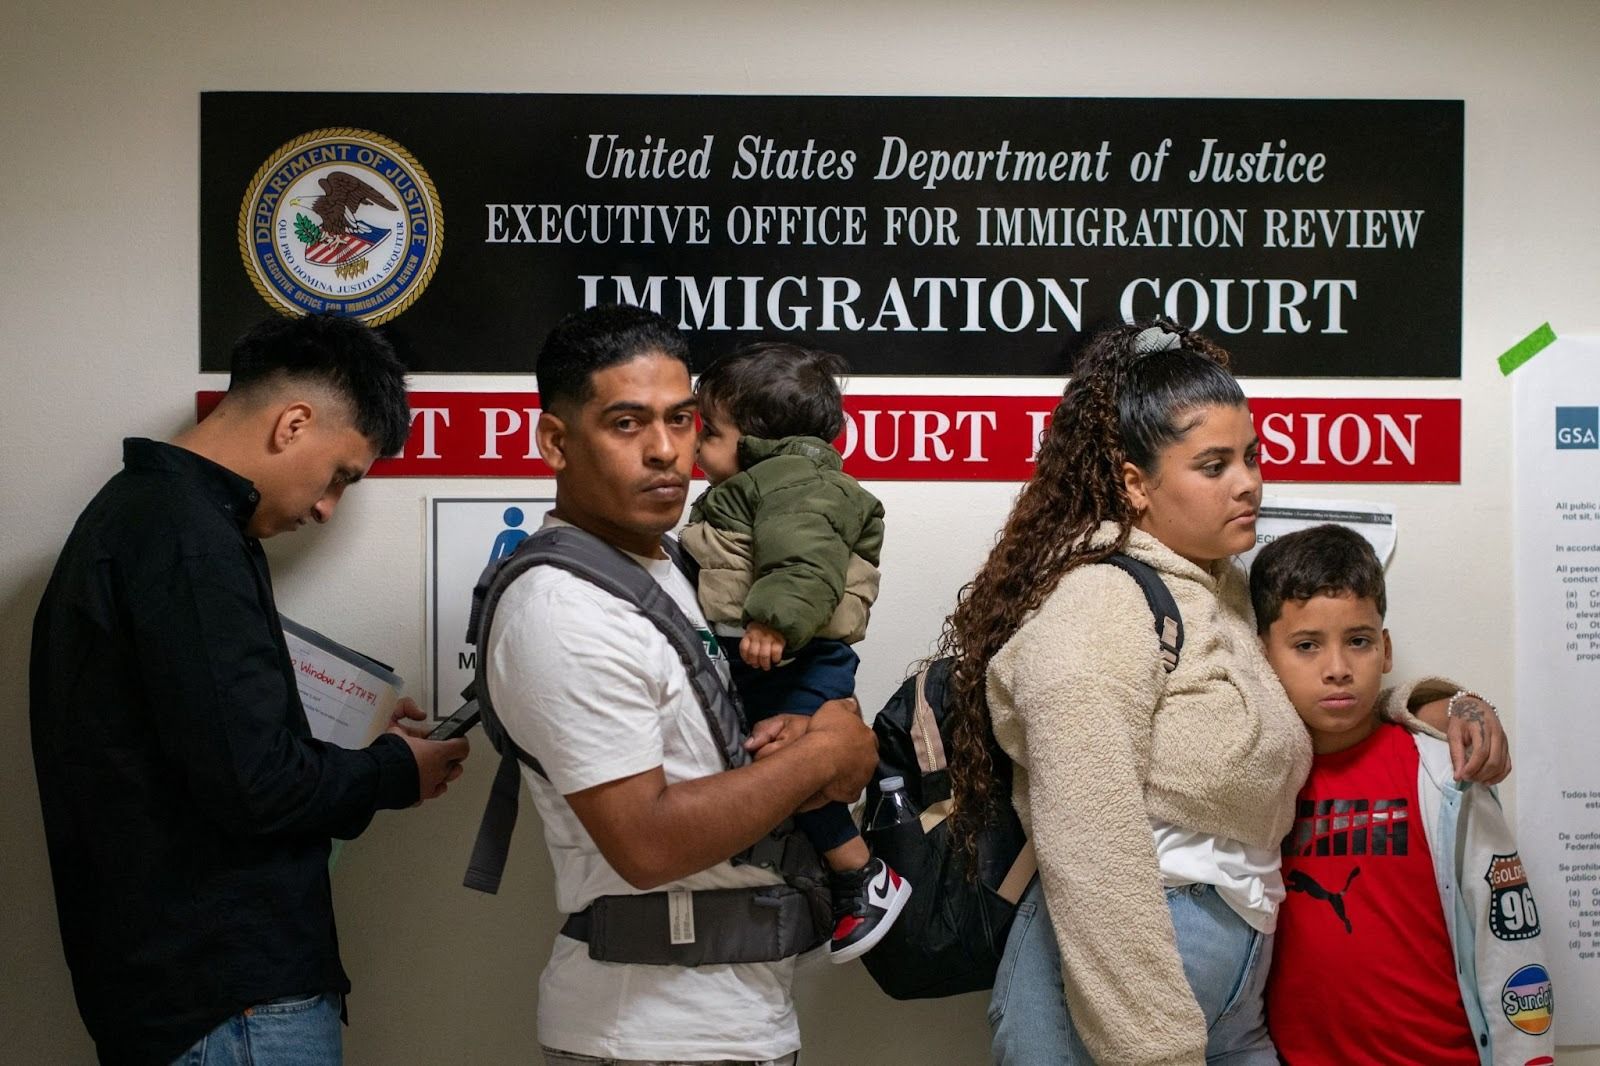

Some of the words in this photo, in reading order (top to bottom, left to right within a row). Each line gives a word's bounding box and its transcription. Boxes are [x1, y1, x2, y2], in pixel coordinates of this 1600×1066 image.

[583, 133, 715, 180] United
[731, 135, 857, 181] States
[874, 136, 1112, 190] Department
[1130, 138, 1172, 183] of
[1189, 138, 1327, 183] Justice
[256, 145, 351, 244] DEPARTMENT
[357, 148, 386, 169] OF
[385, 164, 427, 247] JUSTICE
[278, 219, 287, 240] QUI
[485, 203, 710, 244] EXECUTIVE
[727, 205, 867, 246] OFFICE
[884, 206, 960, 247] FOR
[976, 207, 1247, 248] IMMIGRATION
[1263, 209, 1425, 250] REVIEW
[281, 243, 295, 264] PRO
[383, 221, 405, 273] SEQUITUR
[294, 265, 333, 293] DOMINA
[336, 273, 383, 294] JUSTITIA
[294, 291, 323, 310] OFFICE
[578, 275, 1089, 333] IMMIGRATION
[1119, 278, 1358, 334] COURT
[1557, 427, 1596, 444] GSA
[1556, 502, 1568, 510] All
[1570, 502, 1596, 511] public
[1579, 513, 1592, 521] sit,
[1555, 544, 1564, 552] In
[1556, 565, 1568, 573] All
[1566, 590, 1578, 599] (a)
[1566, 600, 1578, 609] (b)
[1566, 621, 1578, 630] (c)
[1566, 642, 1578, 651] (d)
[300, 661, 335, 686] Window
[1559, 832, 1570, 840] De
[1569, 888, 1580, 897] (a)
[1501, 887, 1537, 931] 96
[1569, 899, 1580, 908] (b)
[1569, 920, 1580, 928] (c)
[1569, 940, 1580, 949] (d)
